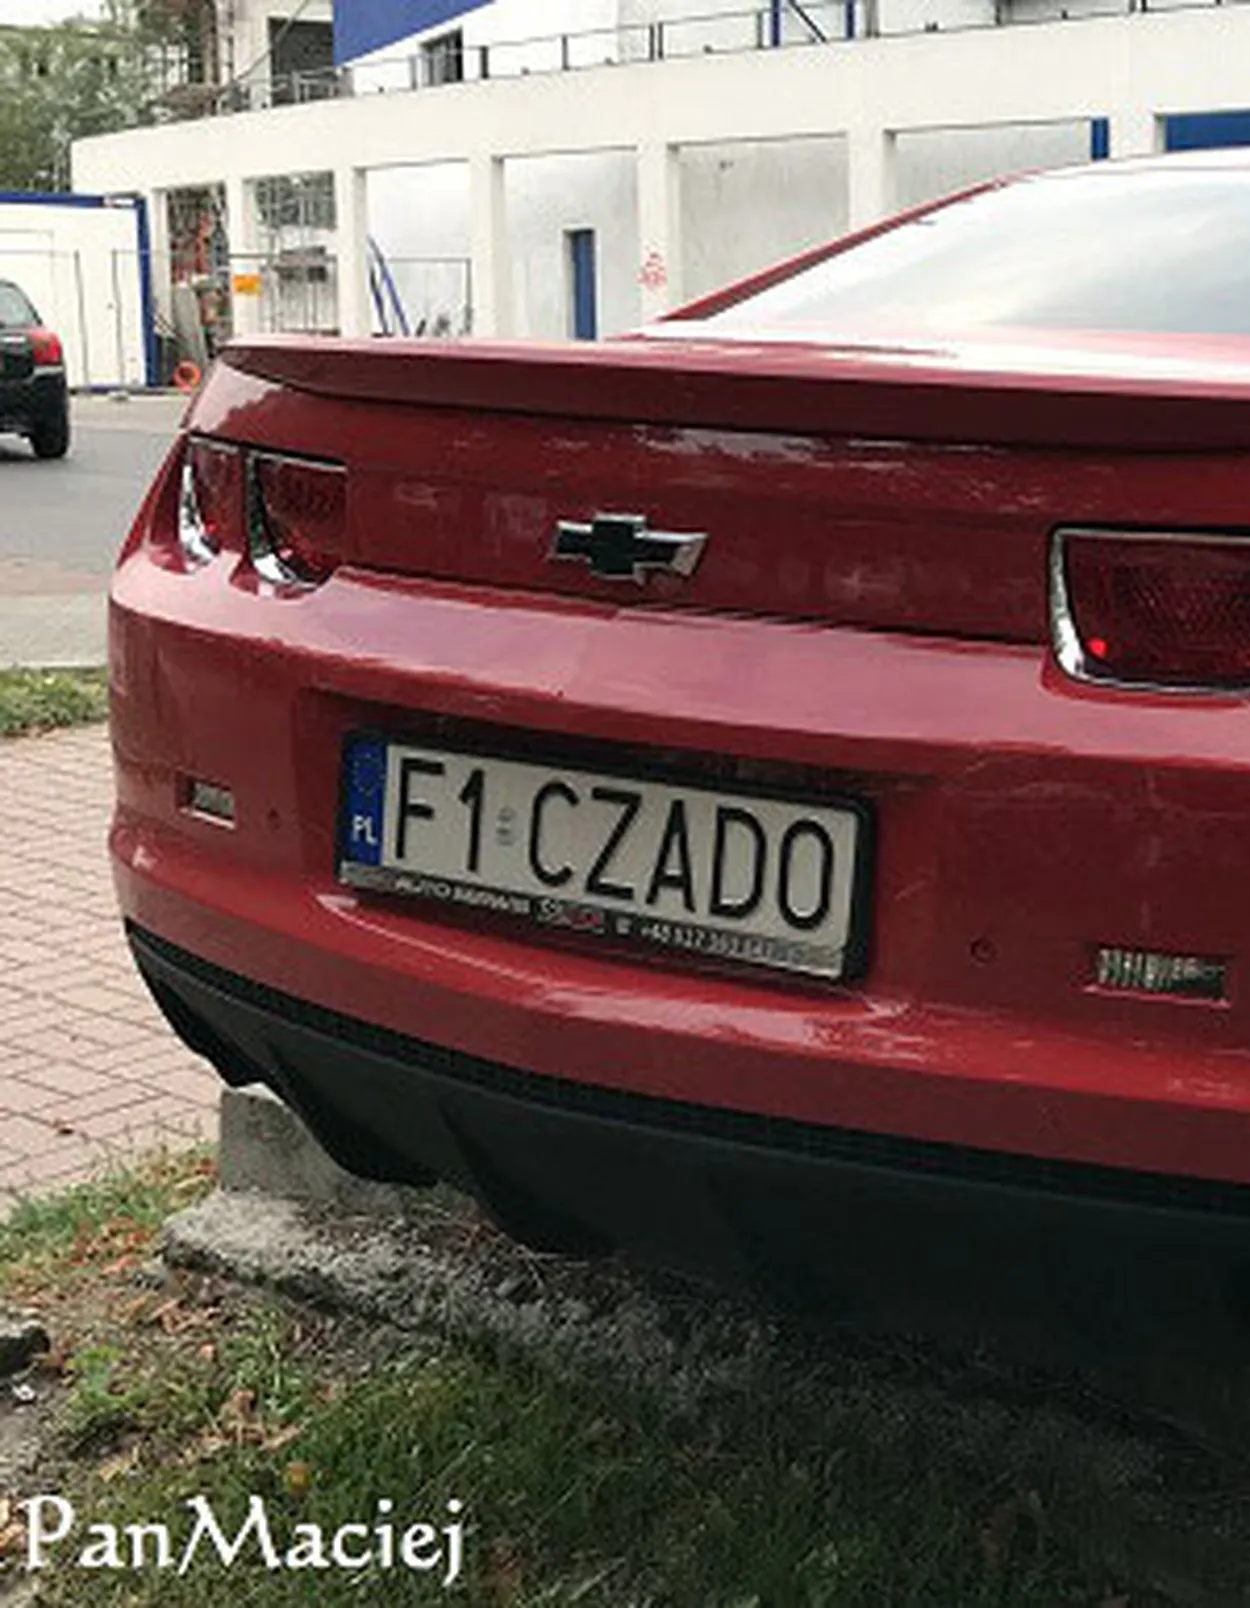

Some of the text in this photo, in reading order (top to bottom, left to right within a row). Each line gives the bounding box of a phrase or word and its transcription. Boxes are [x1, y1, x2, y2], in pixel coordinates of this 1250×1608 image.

[352, 814, 378, 846] PL
[396, 756, 834, 930] F1 CZADO
